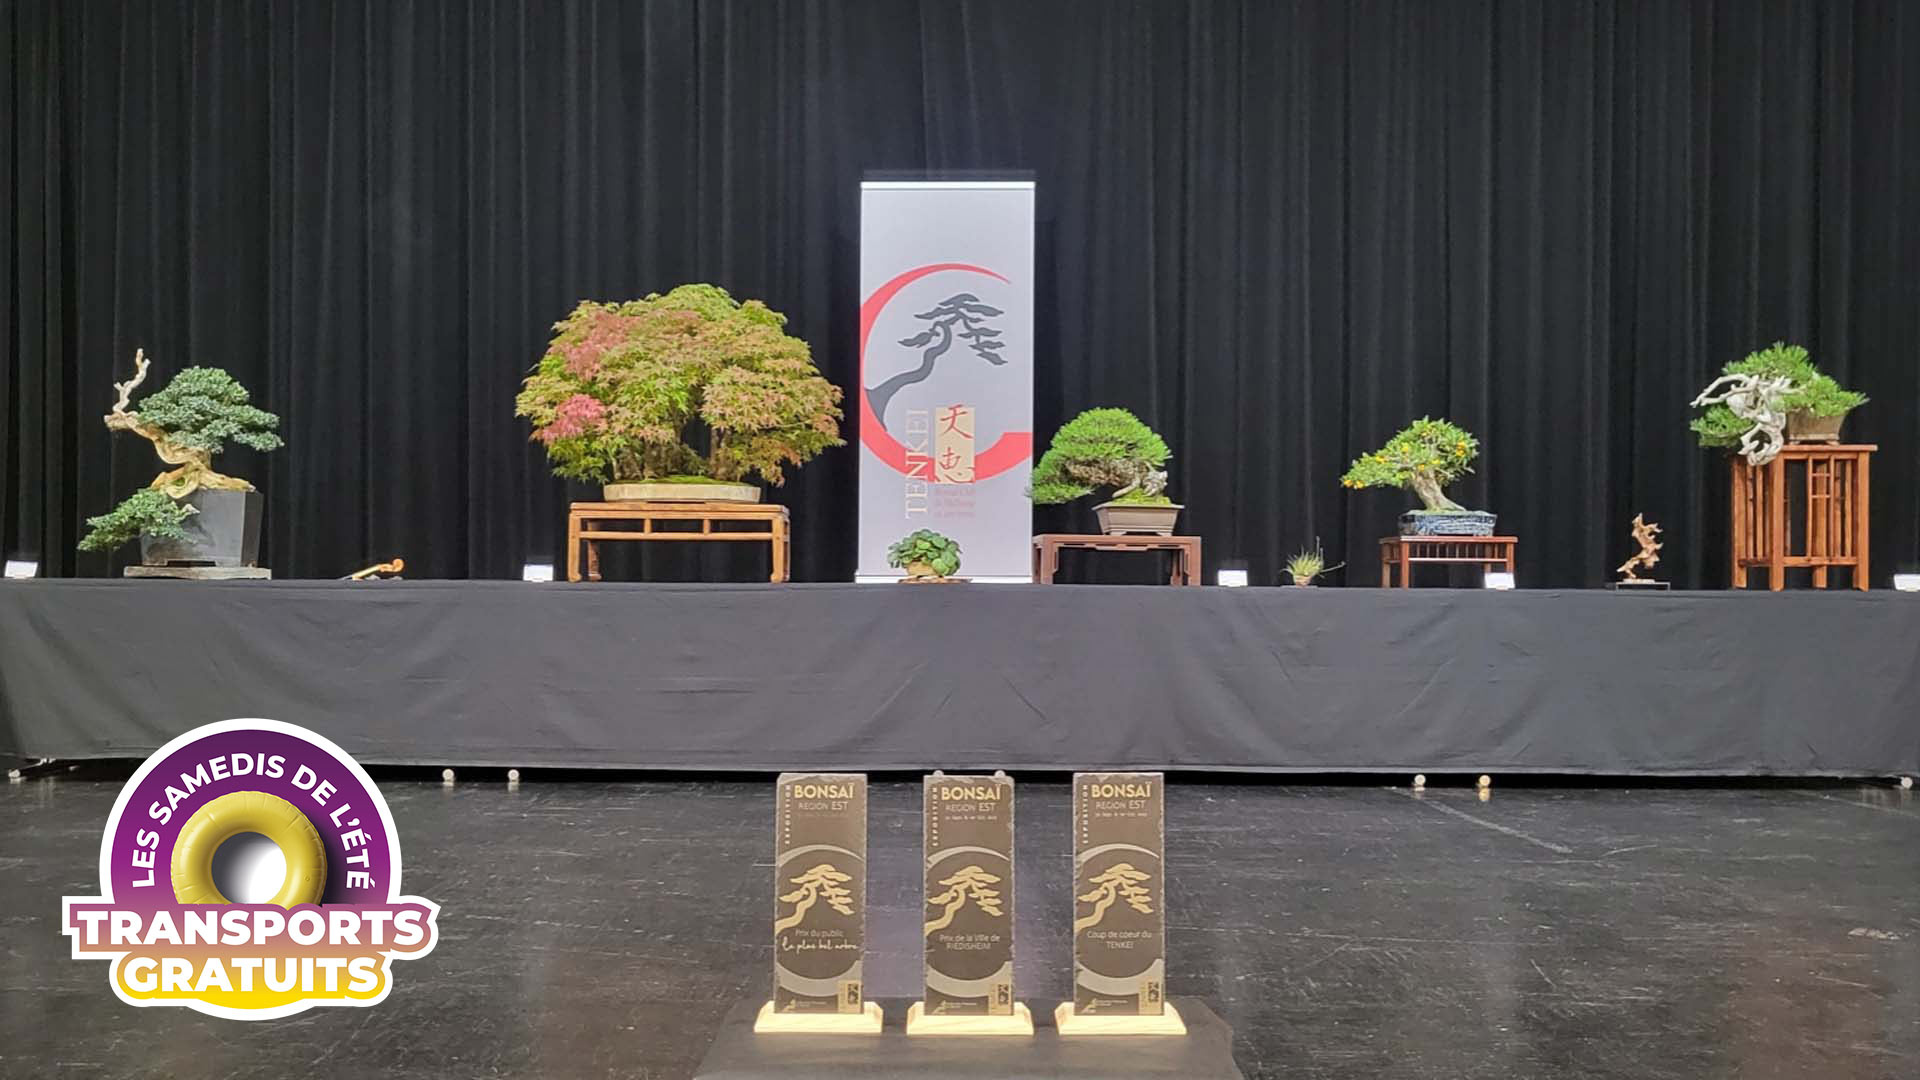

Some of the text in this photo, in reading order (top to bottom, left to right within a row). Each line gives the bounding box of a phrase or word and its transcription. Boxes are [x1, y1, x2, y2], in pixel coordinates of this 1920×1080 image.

[904, 410, 928, 519] TENKEI
[794, 783, 855, 799] BONSAÏ
[1091, 781, 1152, 798] BONSAÏ
[831, 801, 849, 811] EST
[978, 802, 996, 812] EST
[1128, 800, 1146, 810] EST
[1087, 930, 1107, 940] Coup
[1108, 930, 1118, 938] de
